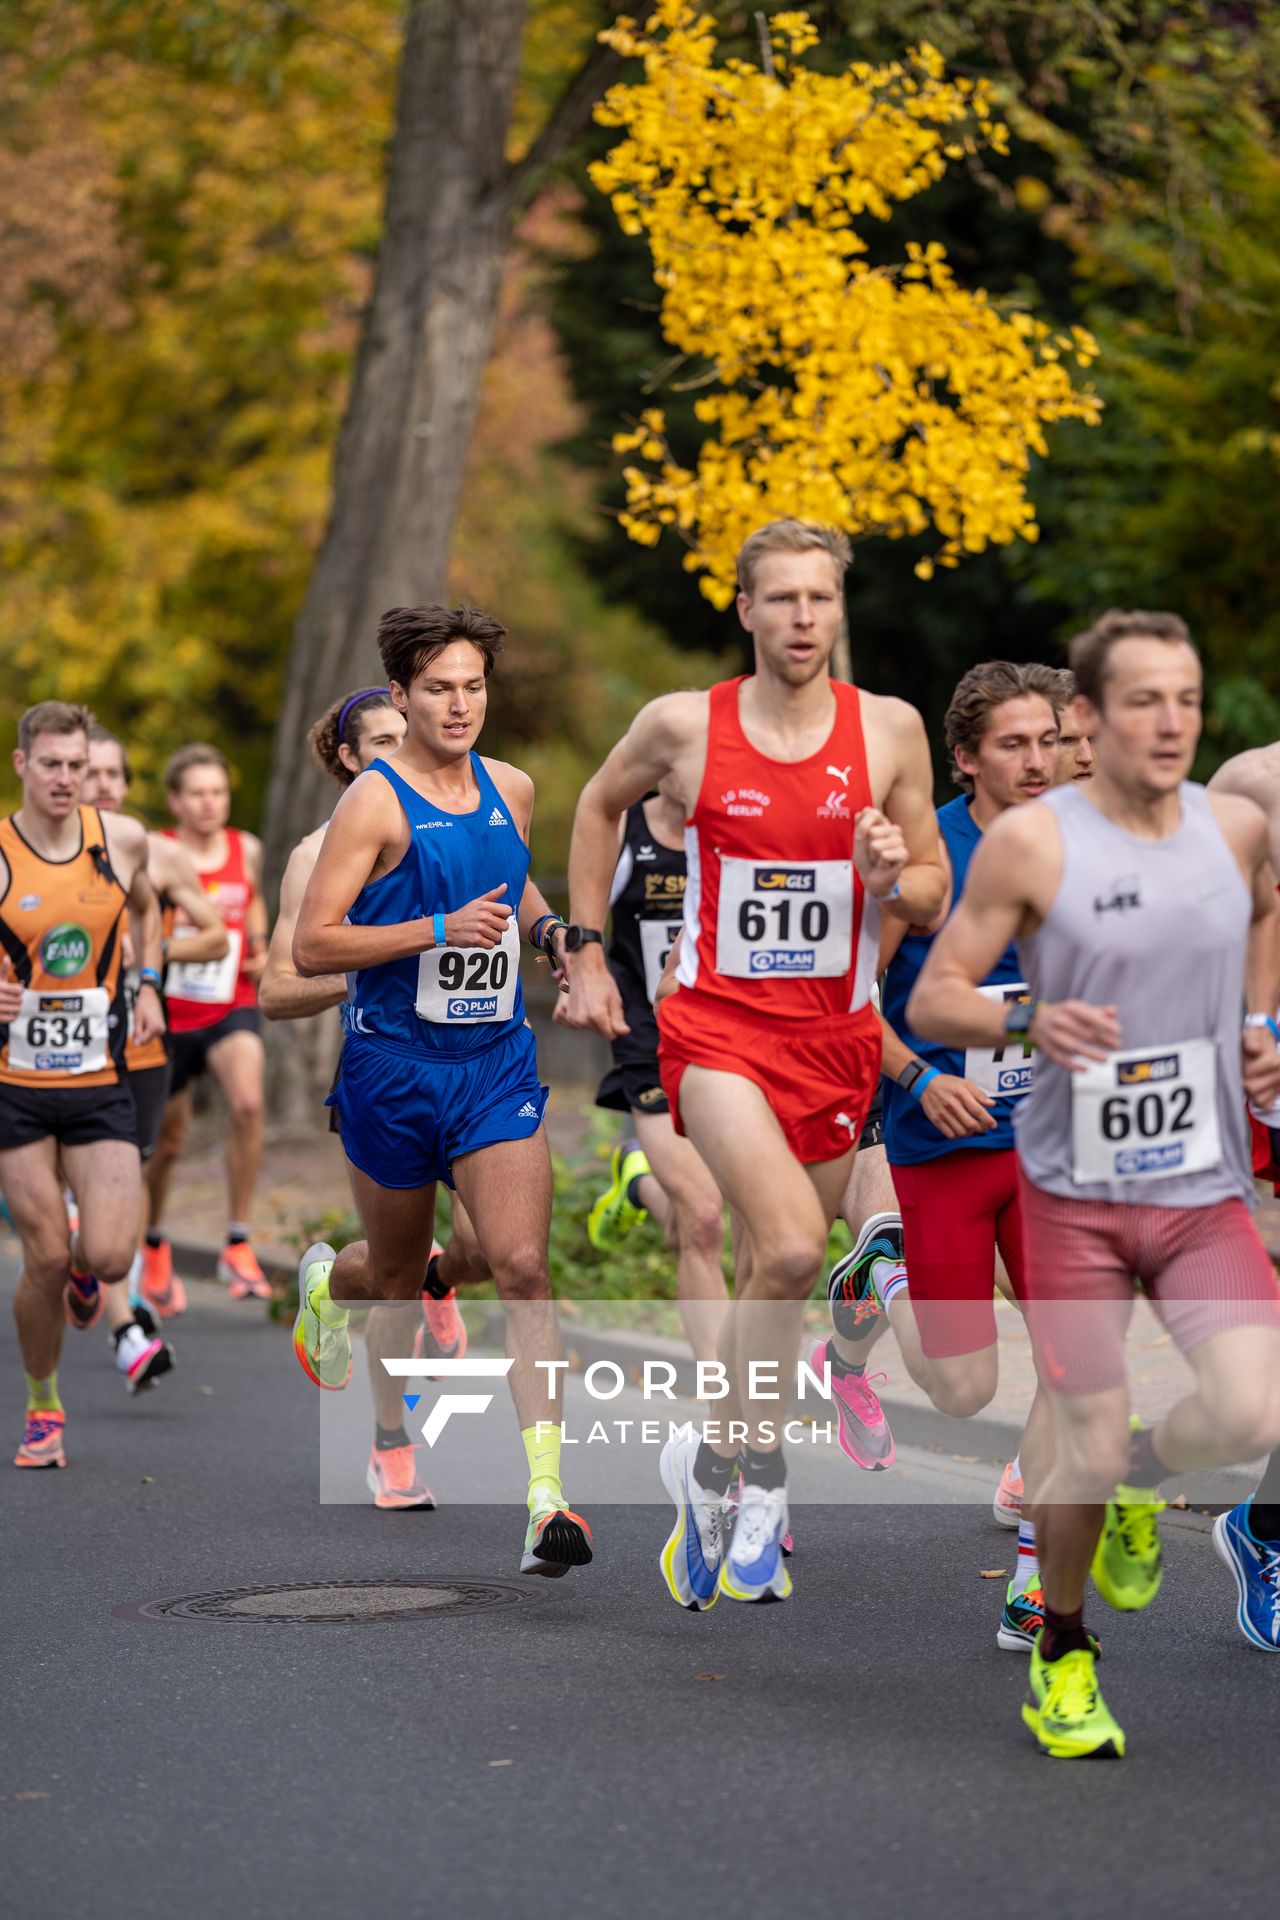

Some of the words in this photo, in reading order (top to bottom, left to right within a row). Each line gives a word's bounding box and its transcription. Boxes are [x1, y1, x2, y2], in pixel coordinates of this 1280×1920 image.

[738, 789, 771, 807] NORD
[727, 804, 763, 817] BERLIN
[488, 818, 508, 827] adidas
[739, 899, 829, 942] 610
[46, 941, 85, 961] EAM
[775, 951, 812, 965] PLAN
[438, 951, 508, 991] 920
[470, 1001, 496, 1011] PLAN
[27, 1016, 92, 1047] 634
[1102, 1087, 1193, 1140] 602
